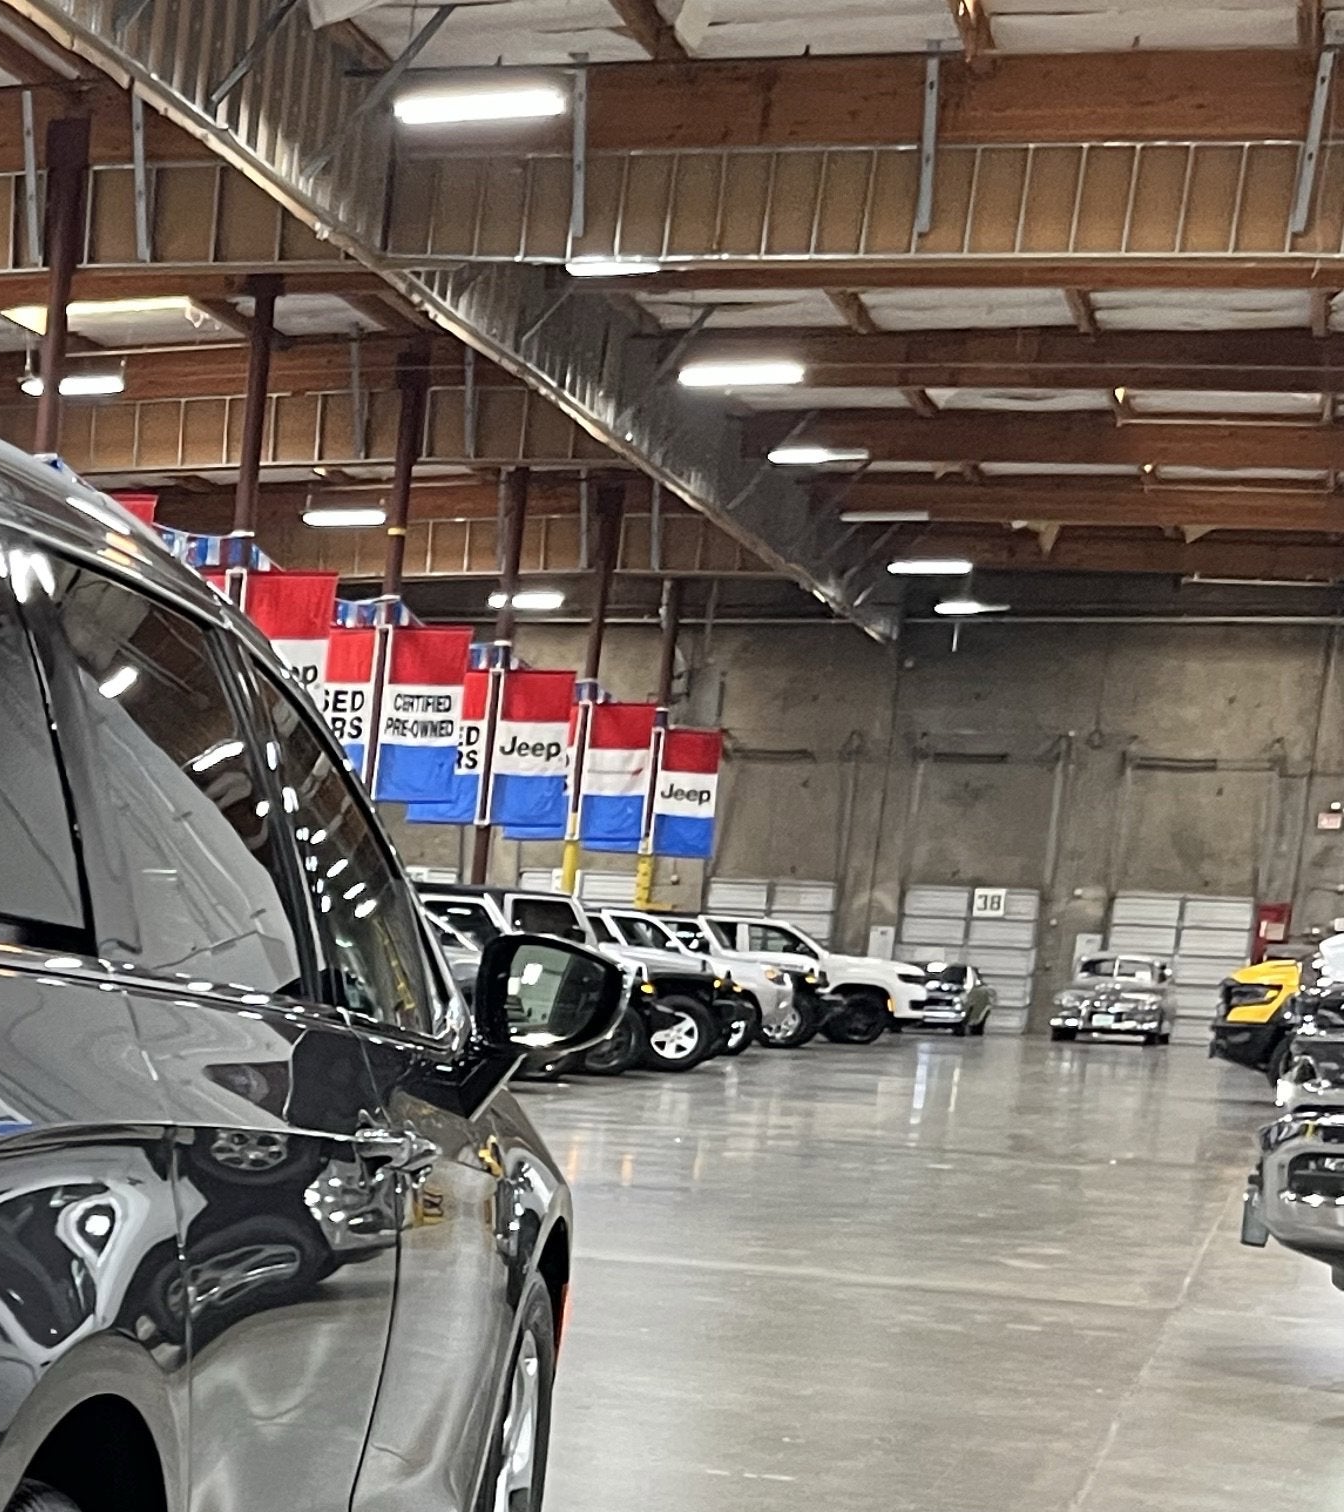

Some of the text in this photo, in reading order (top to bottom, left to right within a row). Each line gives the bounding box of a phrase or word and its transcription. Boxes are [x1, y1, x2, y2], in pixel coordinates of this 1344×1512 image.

[394, 693, 452, 713] CERTIFIED
[384, 717, 454, 738] PRE-OWNED
[499, 735, 561, 762] Jeep
[661, 784, 711, 805] Jeep
[977, 894, 1002, 911] 38
